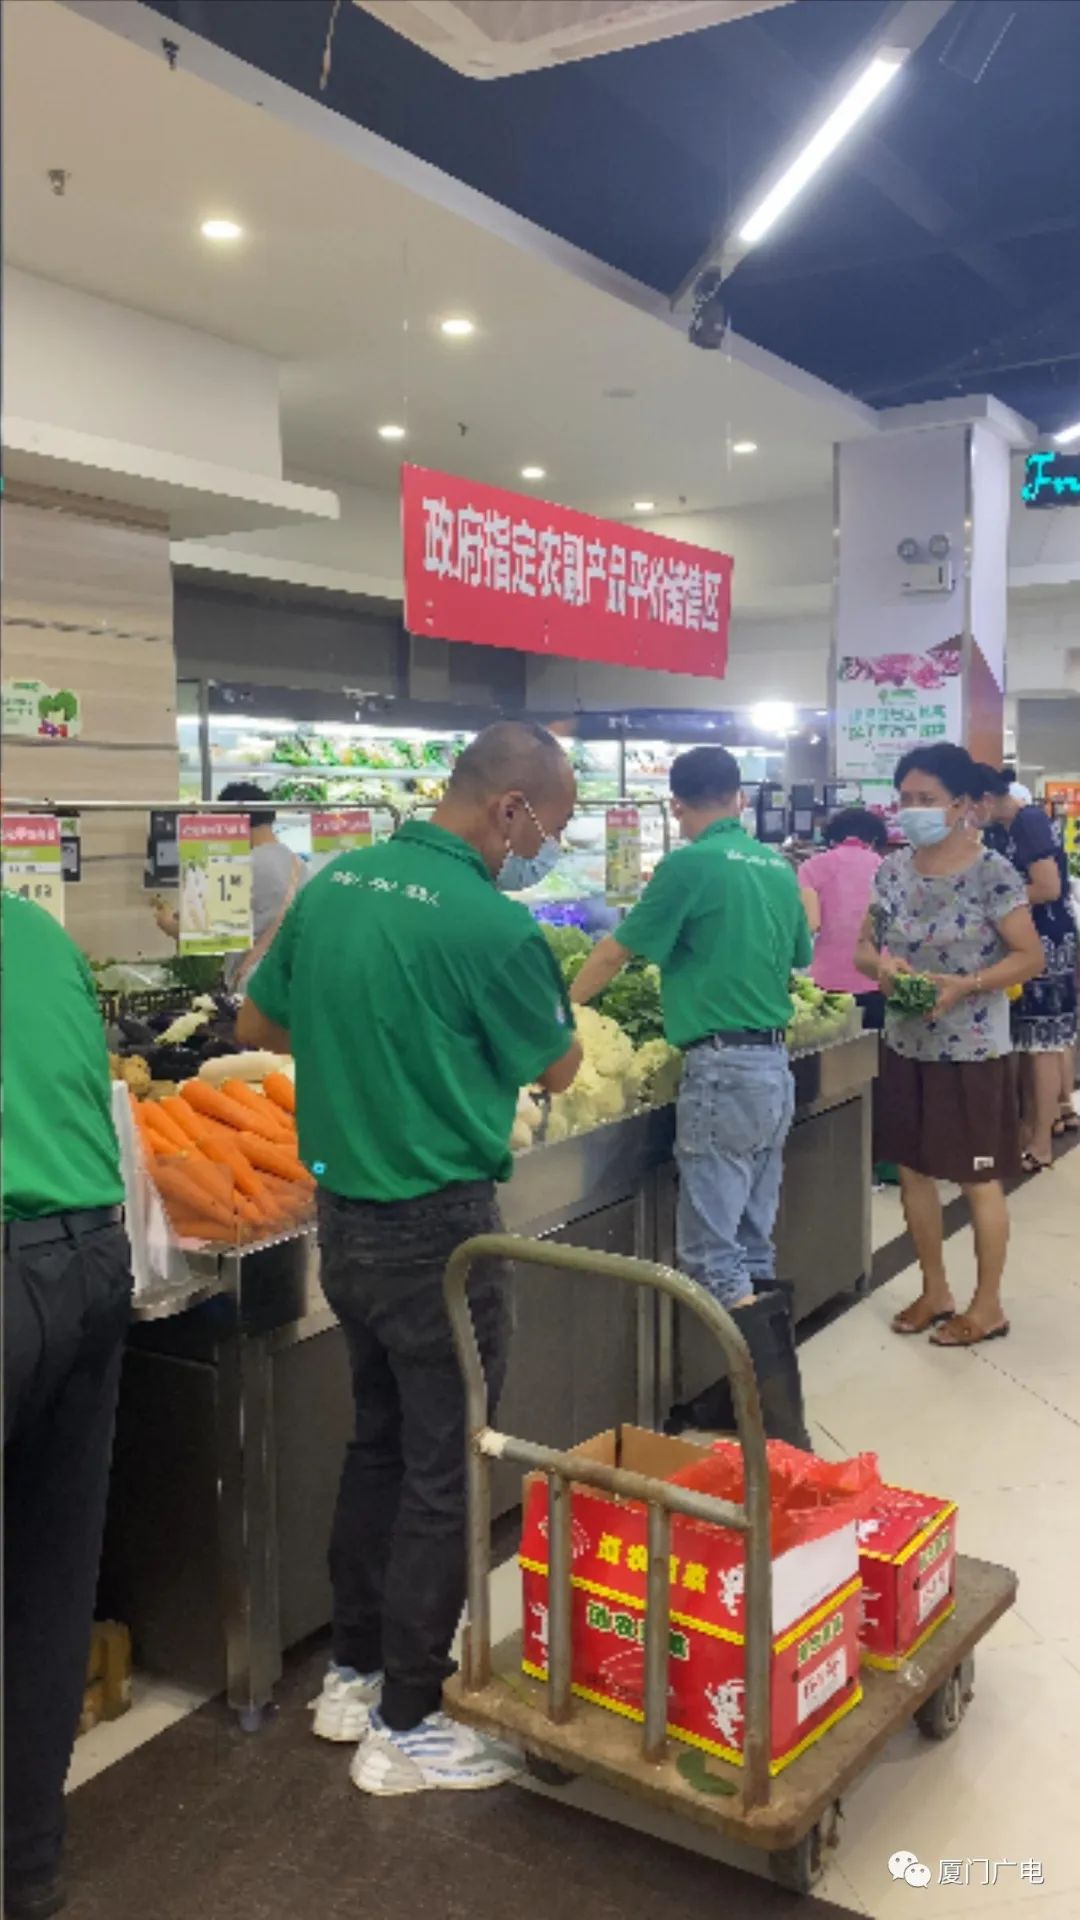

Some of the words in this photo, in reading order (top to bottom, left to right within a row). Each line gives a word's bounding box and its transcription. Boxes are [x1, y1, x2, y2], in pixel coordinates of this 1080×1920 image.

[422, 496, 722, 632] 政府指定农副产品平价销售区
